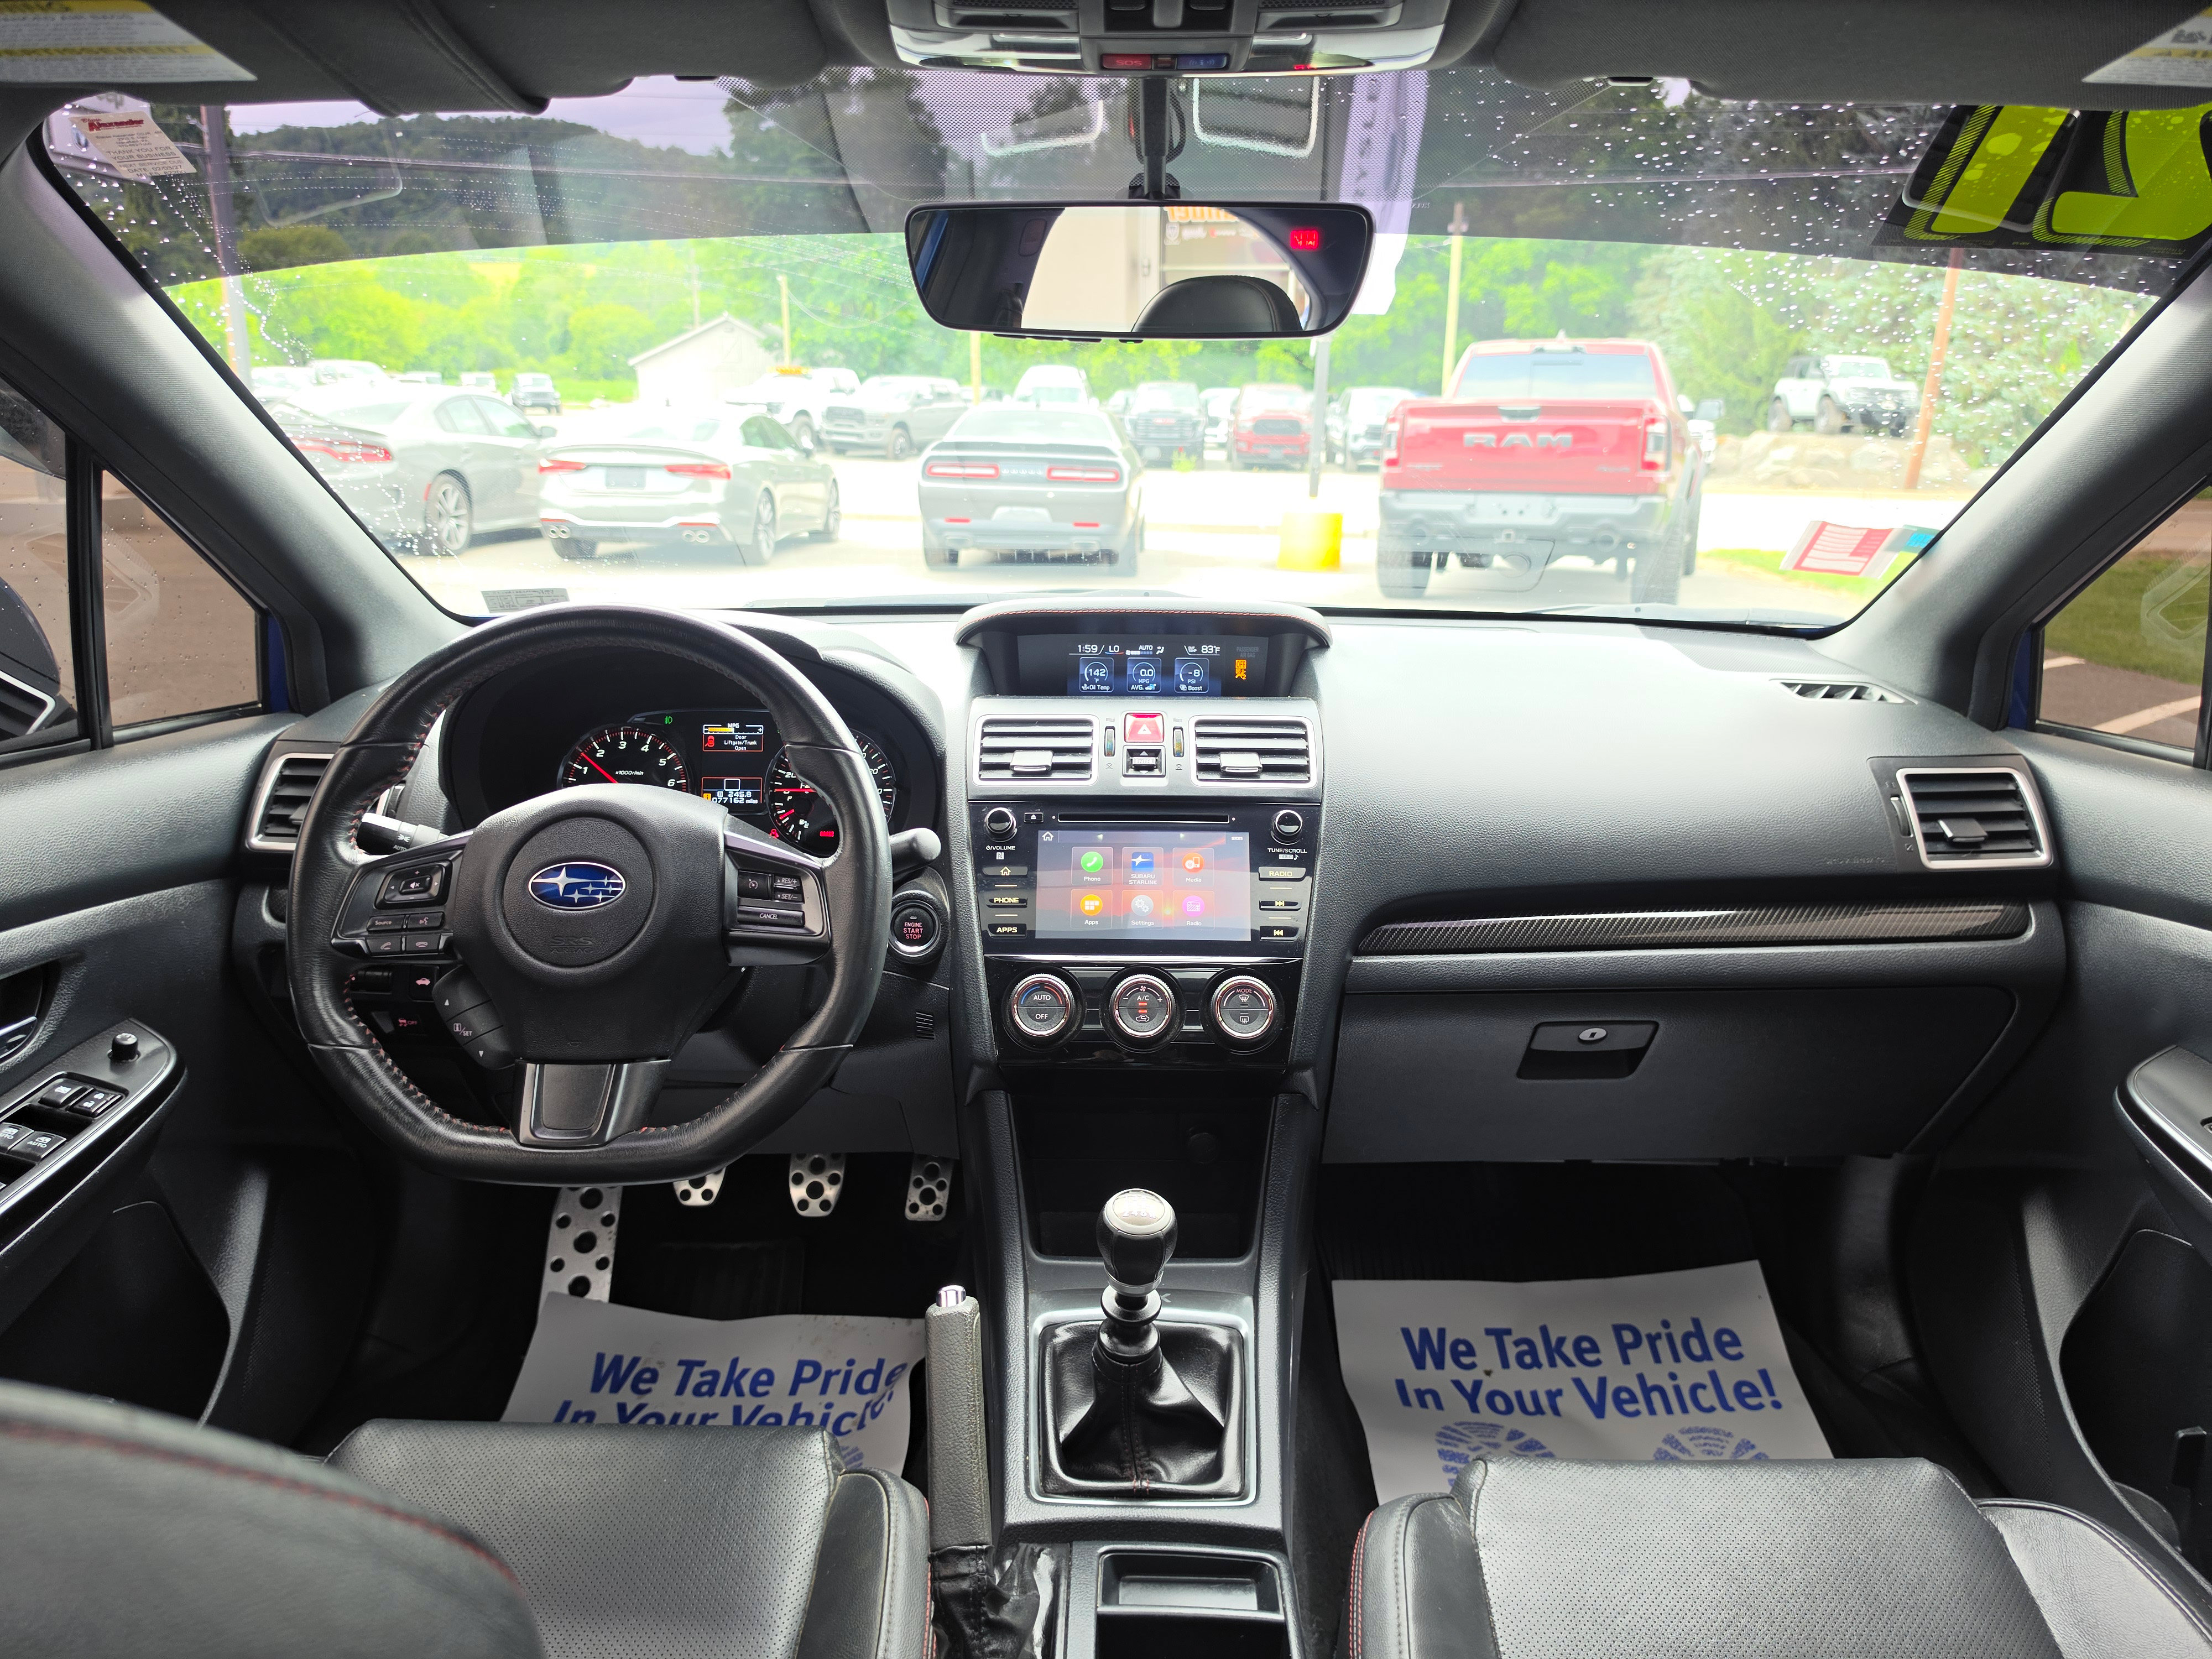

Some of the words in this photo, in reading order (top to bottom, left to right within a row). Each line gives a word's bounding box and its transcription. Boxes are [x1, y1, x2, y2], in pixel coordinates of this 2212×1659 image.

[1464, 435, 1572, 447] RAM
[1078, 645, 1098, 653] 1:59
[1140, 669, 1154, 677] 0.0
[640, 744, 649, 753] 4
[1401, 1327, 1477, 1370] We
[1484, 1324, 1603, 1370] Take
[1611, 1316, 1745, 1365] Pride
[590, 1352, 660, 1395] We
[675, 1356, 775, 1398] Take
[788, 1358, 908, 1396] Pride
[1394, 1378, 1444, 1411] In
[1451, 1379, 1564, 1417] Your
[1570, 1368, 1783, 1420] Vehicle!
